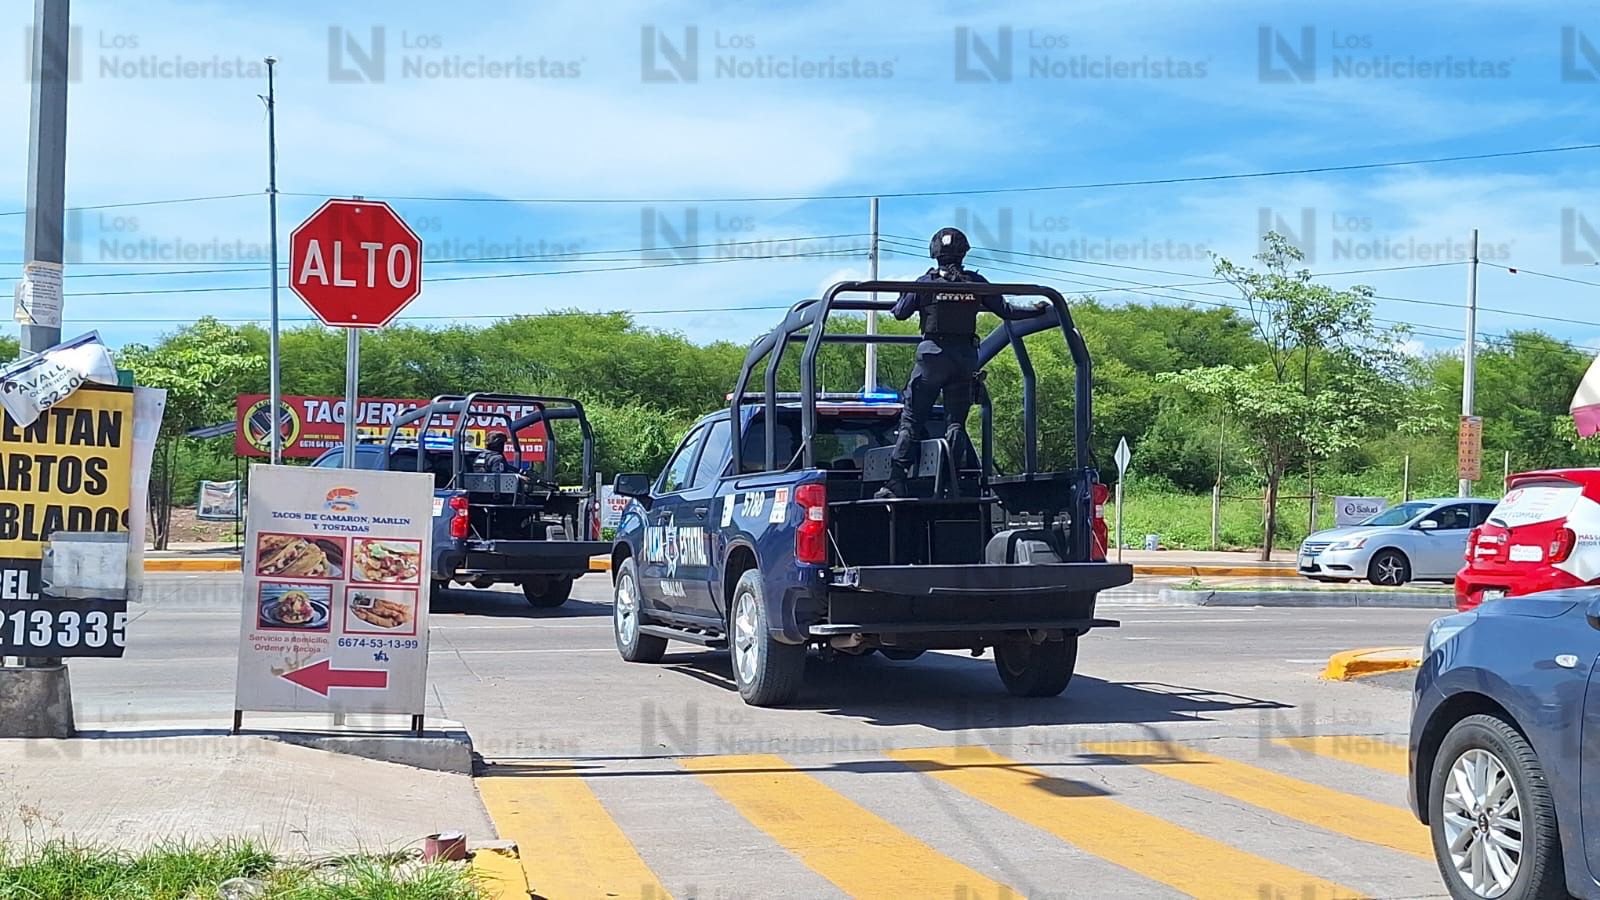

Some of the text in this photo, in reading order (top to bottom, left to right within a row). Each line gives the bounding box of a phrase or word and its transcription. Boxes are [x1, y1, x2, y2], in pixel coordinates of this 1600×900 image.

[299, 239, 412, 289] ALTO
[1356, 505, 1378, 513] Salud
[272, 511, 301, 520] TACOS
[304, 513, 318, 521] DE
[372, 517, 411, 525] MARLIN
[313, 522, 370, 532] Y TOSTADAS
[0, 569, 39, 600] EL.
[249, 633, 282, 643] Servicio
[338, 637, 418, 649] 6674-53-13-99
[254, 644, 285, 652] Ordene
